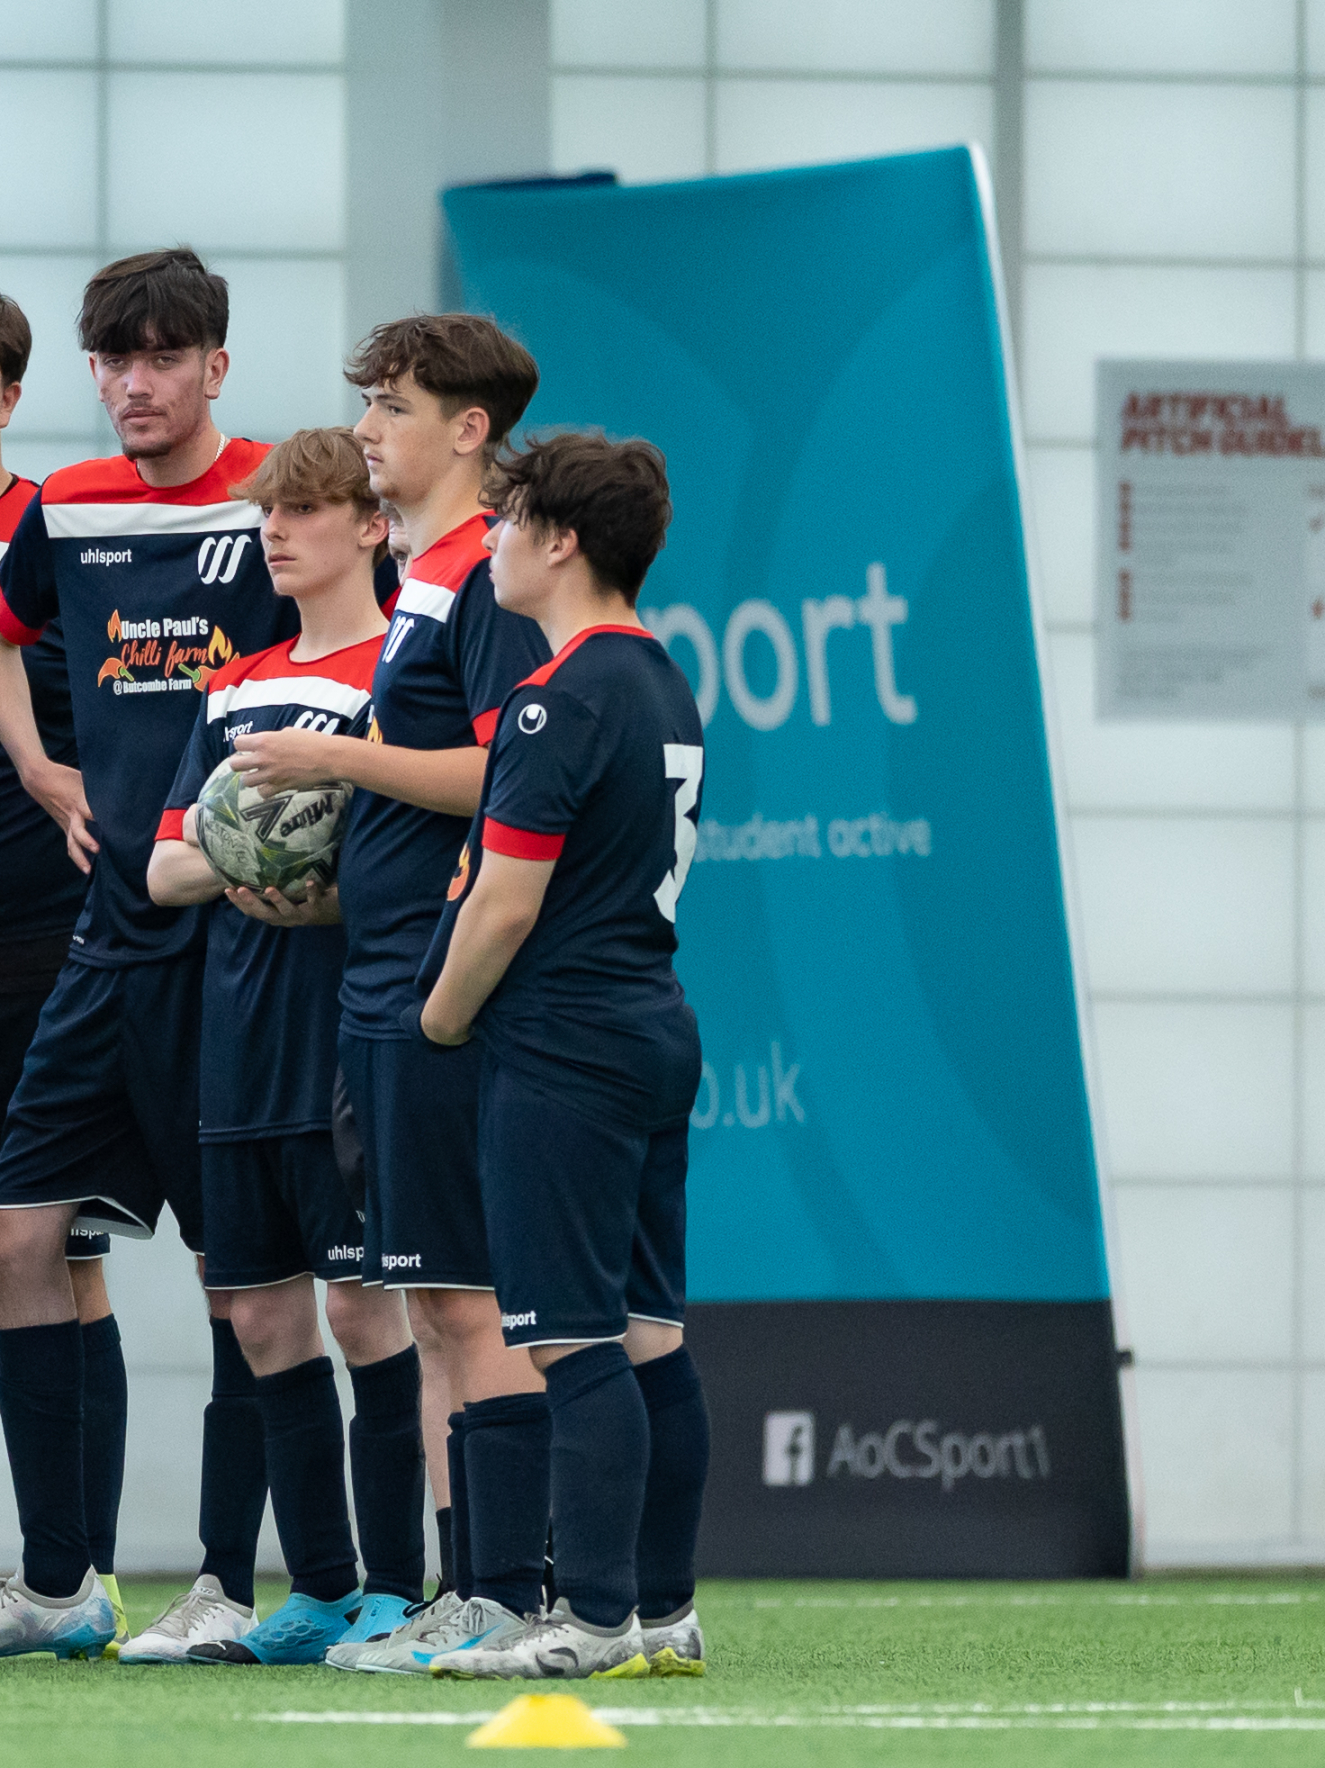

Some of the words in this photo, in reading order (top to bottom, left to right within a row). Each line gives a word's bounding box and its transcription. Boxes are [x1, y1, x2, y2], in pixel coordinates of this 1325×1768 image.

[80, 548, 132, 566] uhlsport
[121, 619, 161, 640] Uncle
[163, 616, 209, 638] Paul's
[121, 640, 162, 670] Chilli
[168, 678, 192, 691] Farm
[653, 743, 705, 925] 3
[327, 1244, 364, 1262] uhlsp
